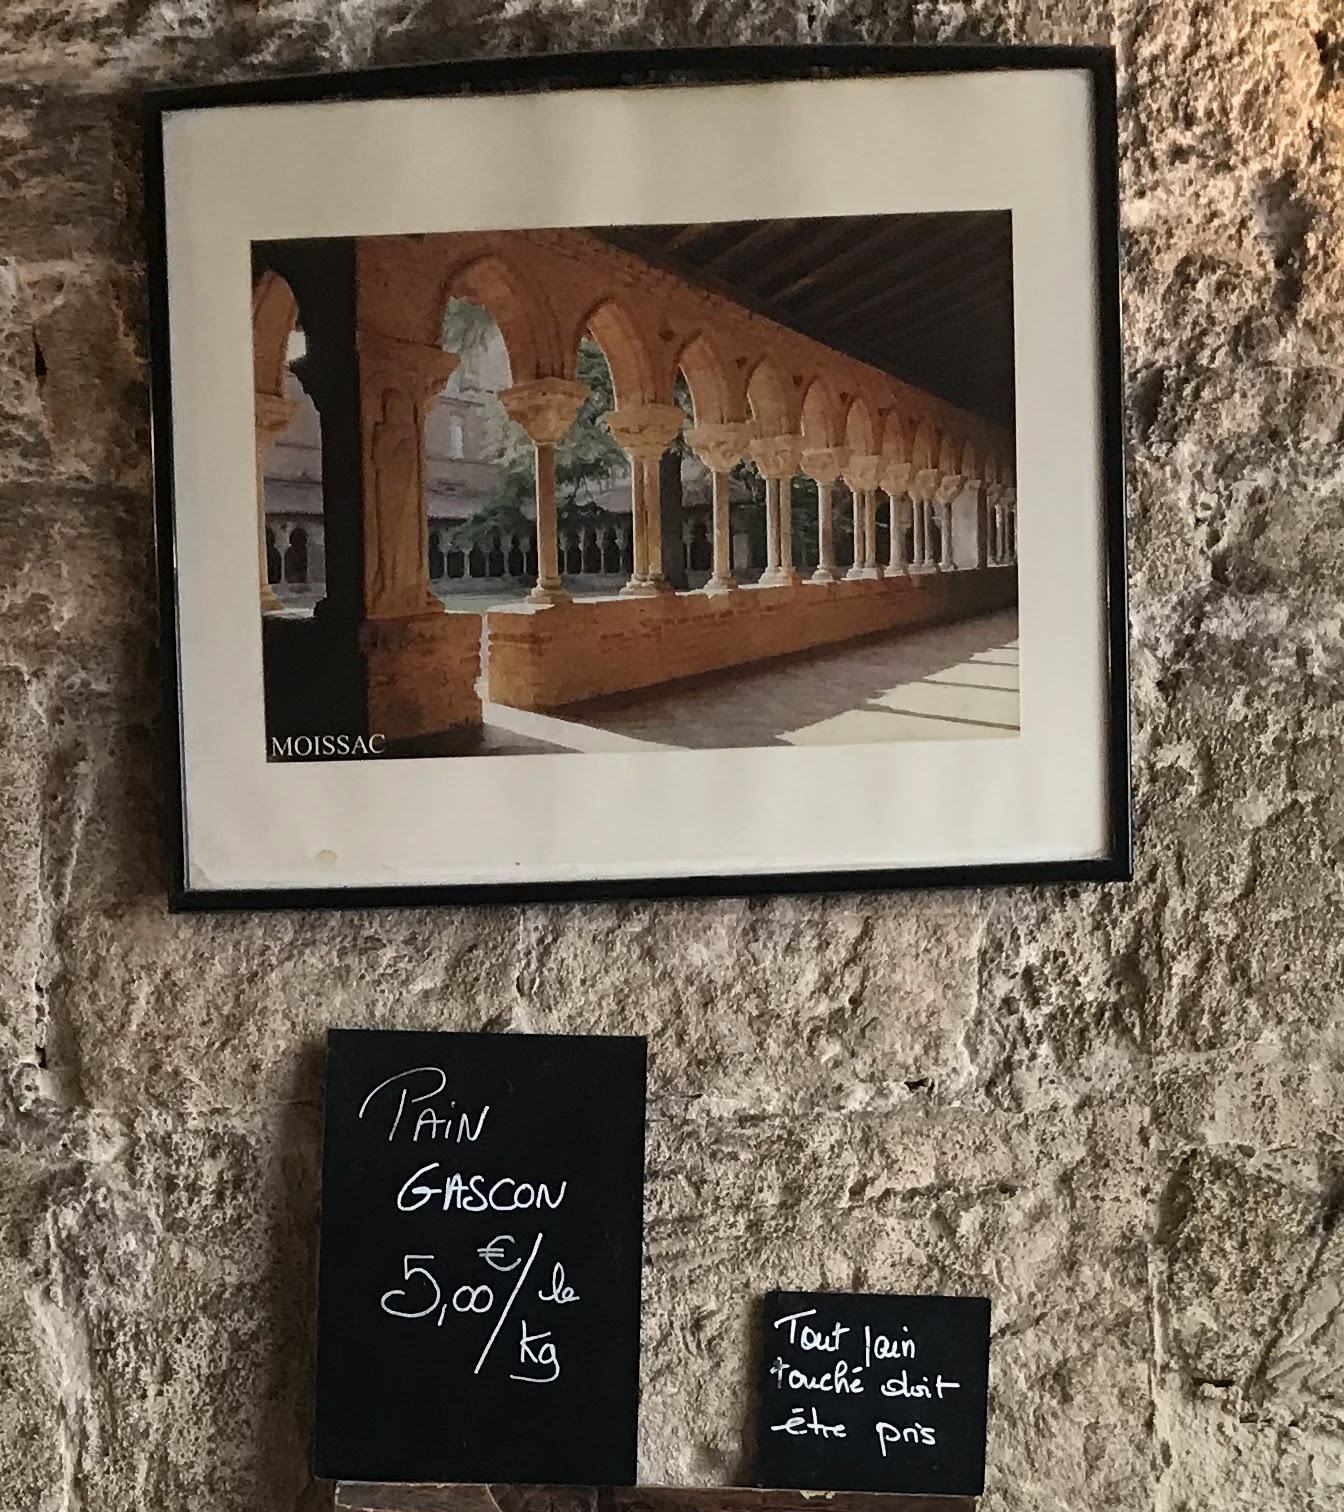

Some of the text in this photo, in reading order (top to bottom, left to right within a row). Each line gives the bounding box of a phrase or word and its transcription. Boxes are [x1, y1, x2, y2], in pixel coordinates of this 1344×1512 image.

[271, 733, 386, 757] MOISSAC
[396, 1162, 567, 1212] GASCON
[773, 1308, 851, 1352] Tout
[880, 1369, 961, 1399] doit
[770, 1406, 937, 1457] être pris
